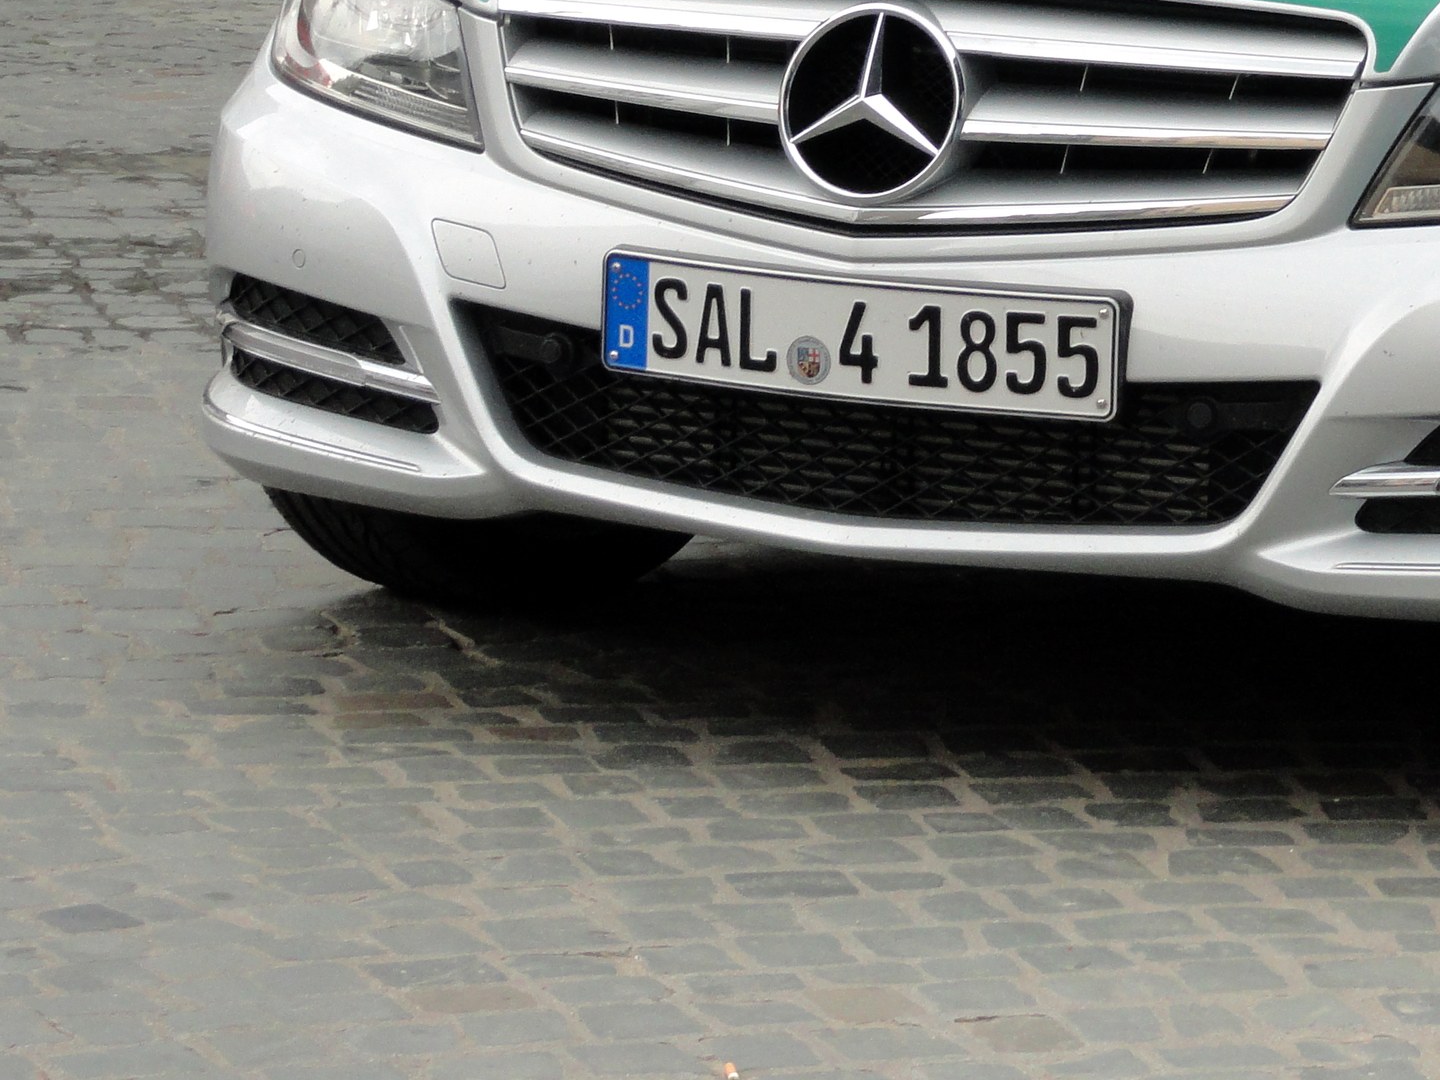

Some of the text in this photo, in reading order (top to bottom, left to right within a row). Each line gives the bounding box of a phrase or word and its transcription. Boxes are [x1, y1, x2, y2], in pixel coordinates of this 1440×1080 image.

[618, 324, 634, 348] D
[651, 277, 778, 373] SAL
[838, 300, 879, 384] 4
[908, 305, 1099, 399] 1855
